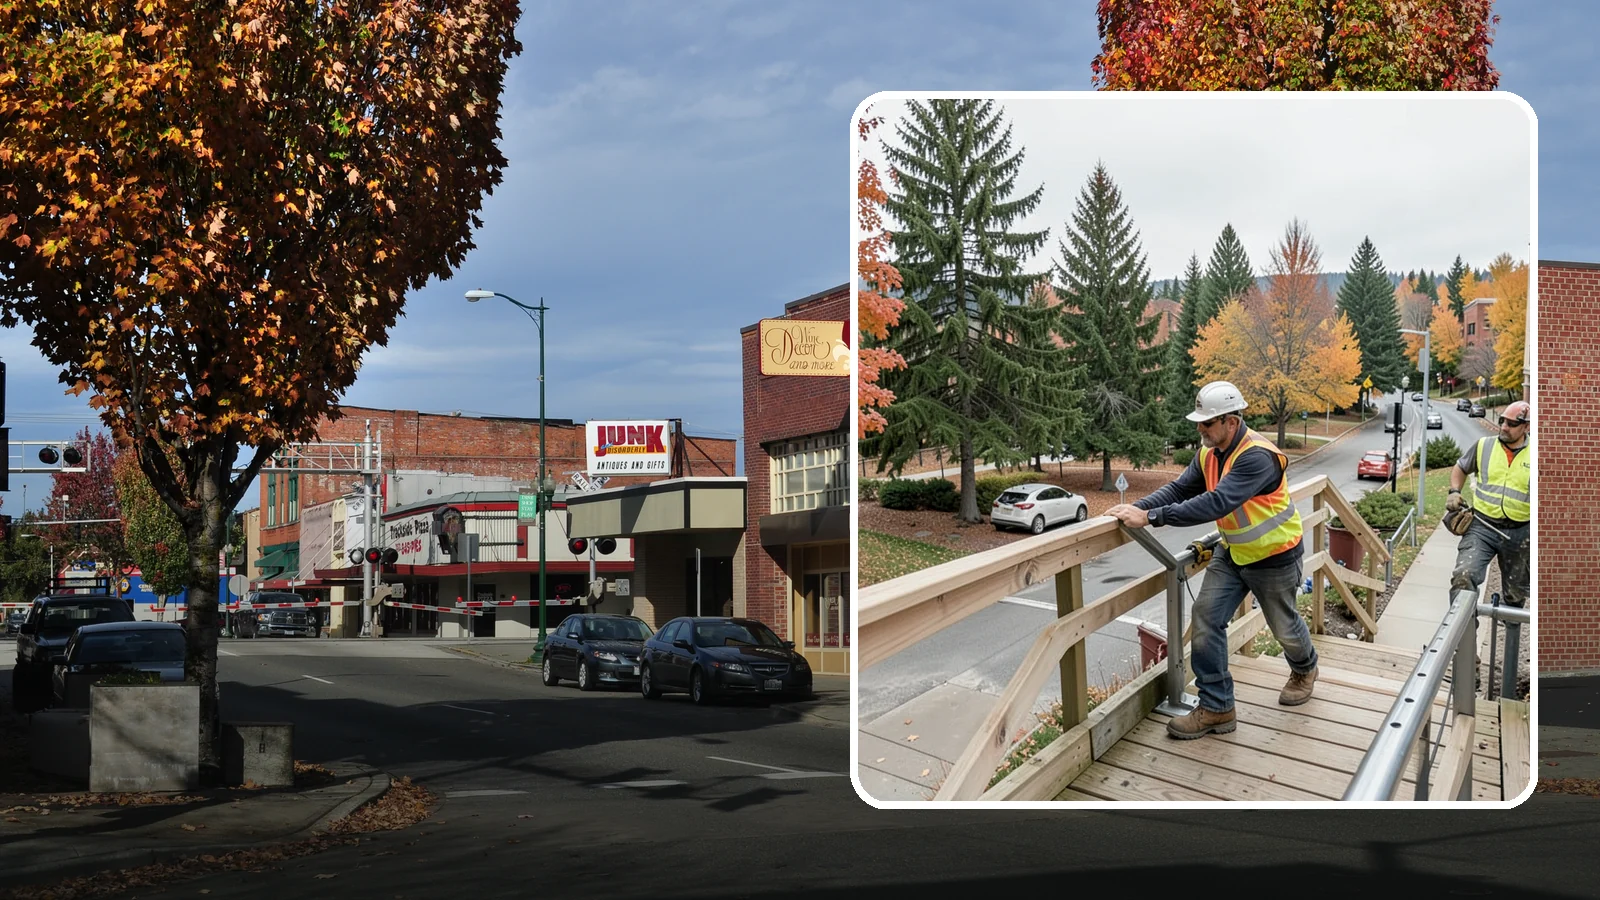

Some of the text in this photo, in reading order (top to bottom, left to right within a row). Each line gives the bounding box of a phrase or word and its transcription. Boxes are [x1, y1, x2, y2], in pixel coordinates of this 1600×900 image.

[595, 425, 665, 457] JUNK
[607, 446, 646, 454] DISORDERLY
[597, 460, 665, 470] ANTIQUES AND GIFTS
